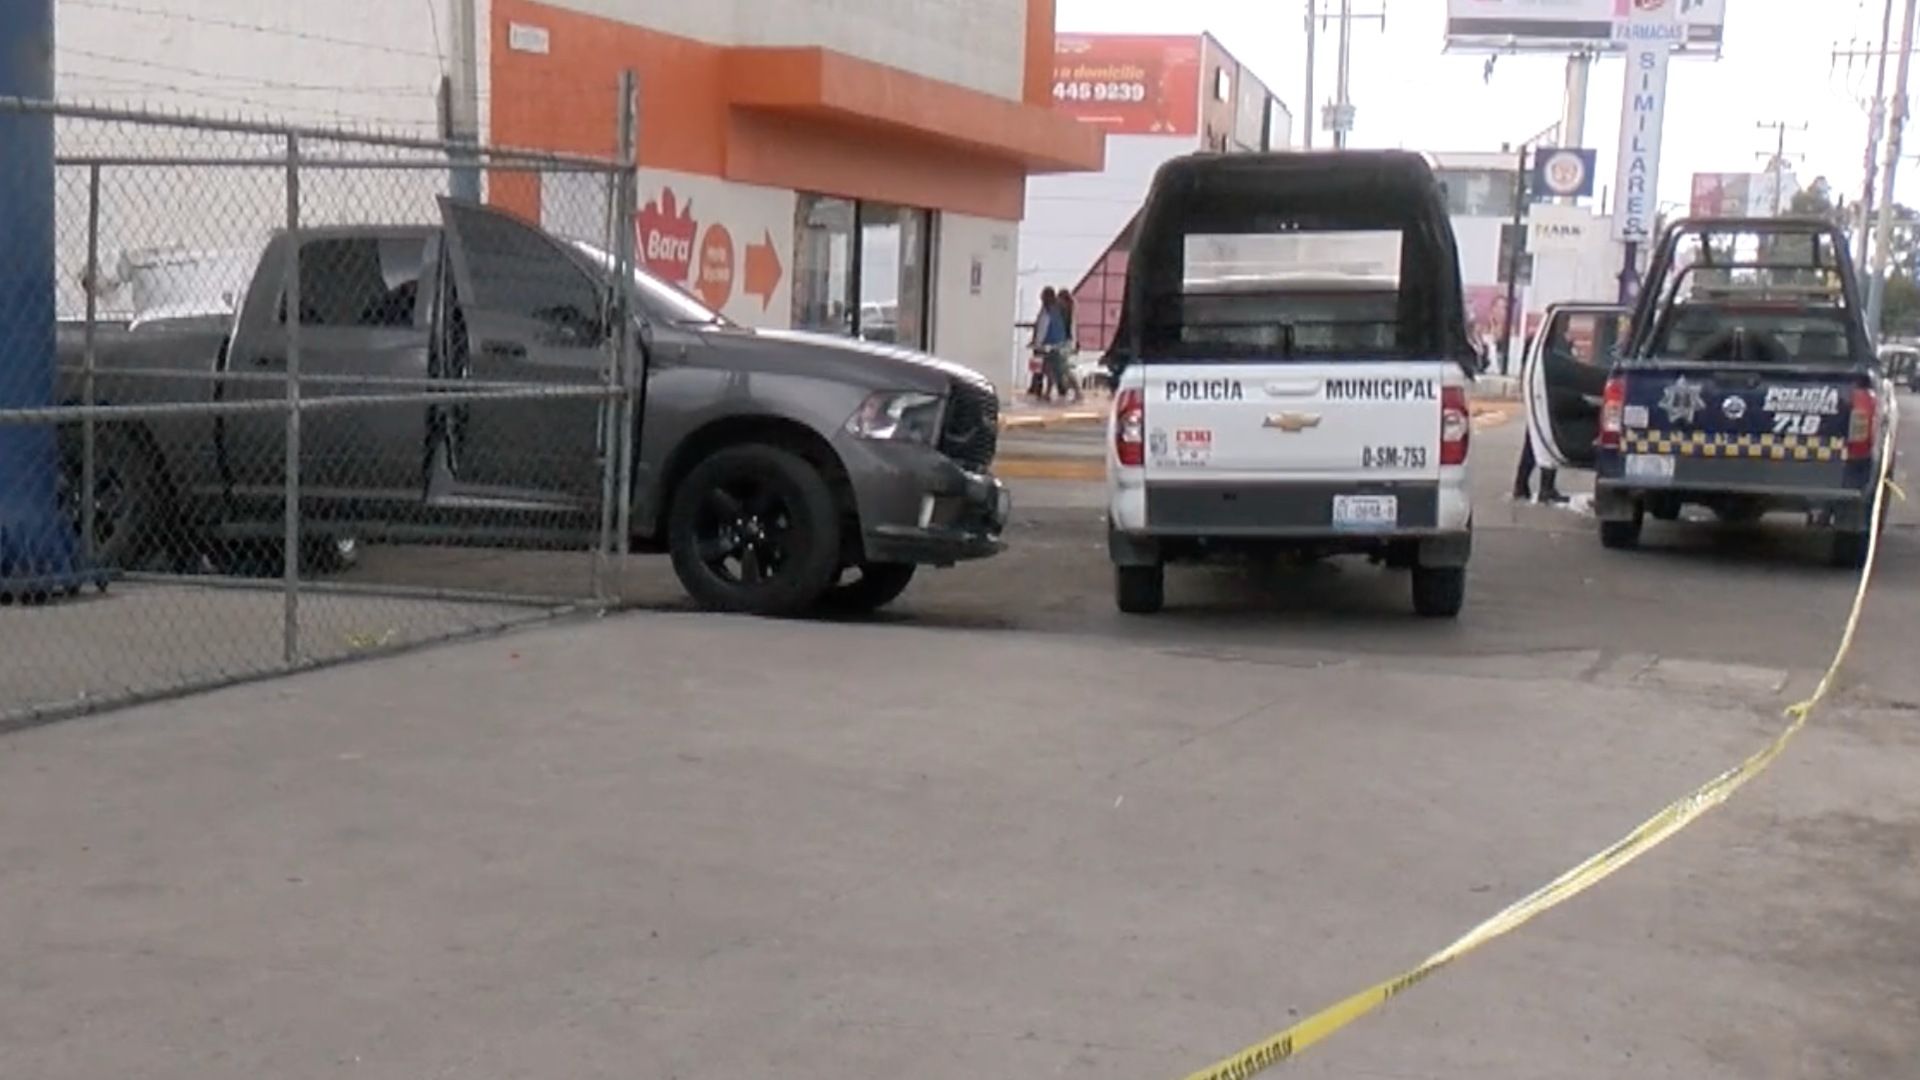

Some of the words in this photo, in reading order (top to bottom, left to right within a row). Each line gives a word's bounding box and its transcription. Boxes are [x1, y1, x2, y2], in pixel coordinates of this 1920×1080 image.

[1616, 24, 1683, 39] FARMACIAS
[1074, 64, 1145, 80] domicilio
[1623, 52, 1655, 236] SIMILARES
[647, 229, 689, 262] Bara
[1325, 378, 1437, 401] MUNICIPAL
[1765, 385, 1839, 402] POLICÍA
[1362, 446, 1426, 469] D-SM-753
